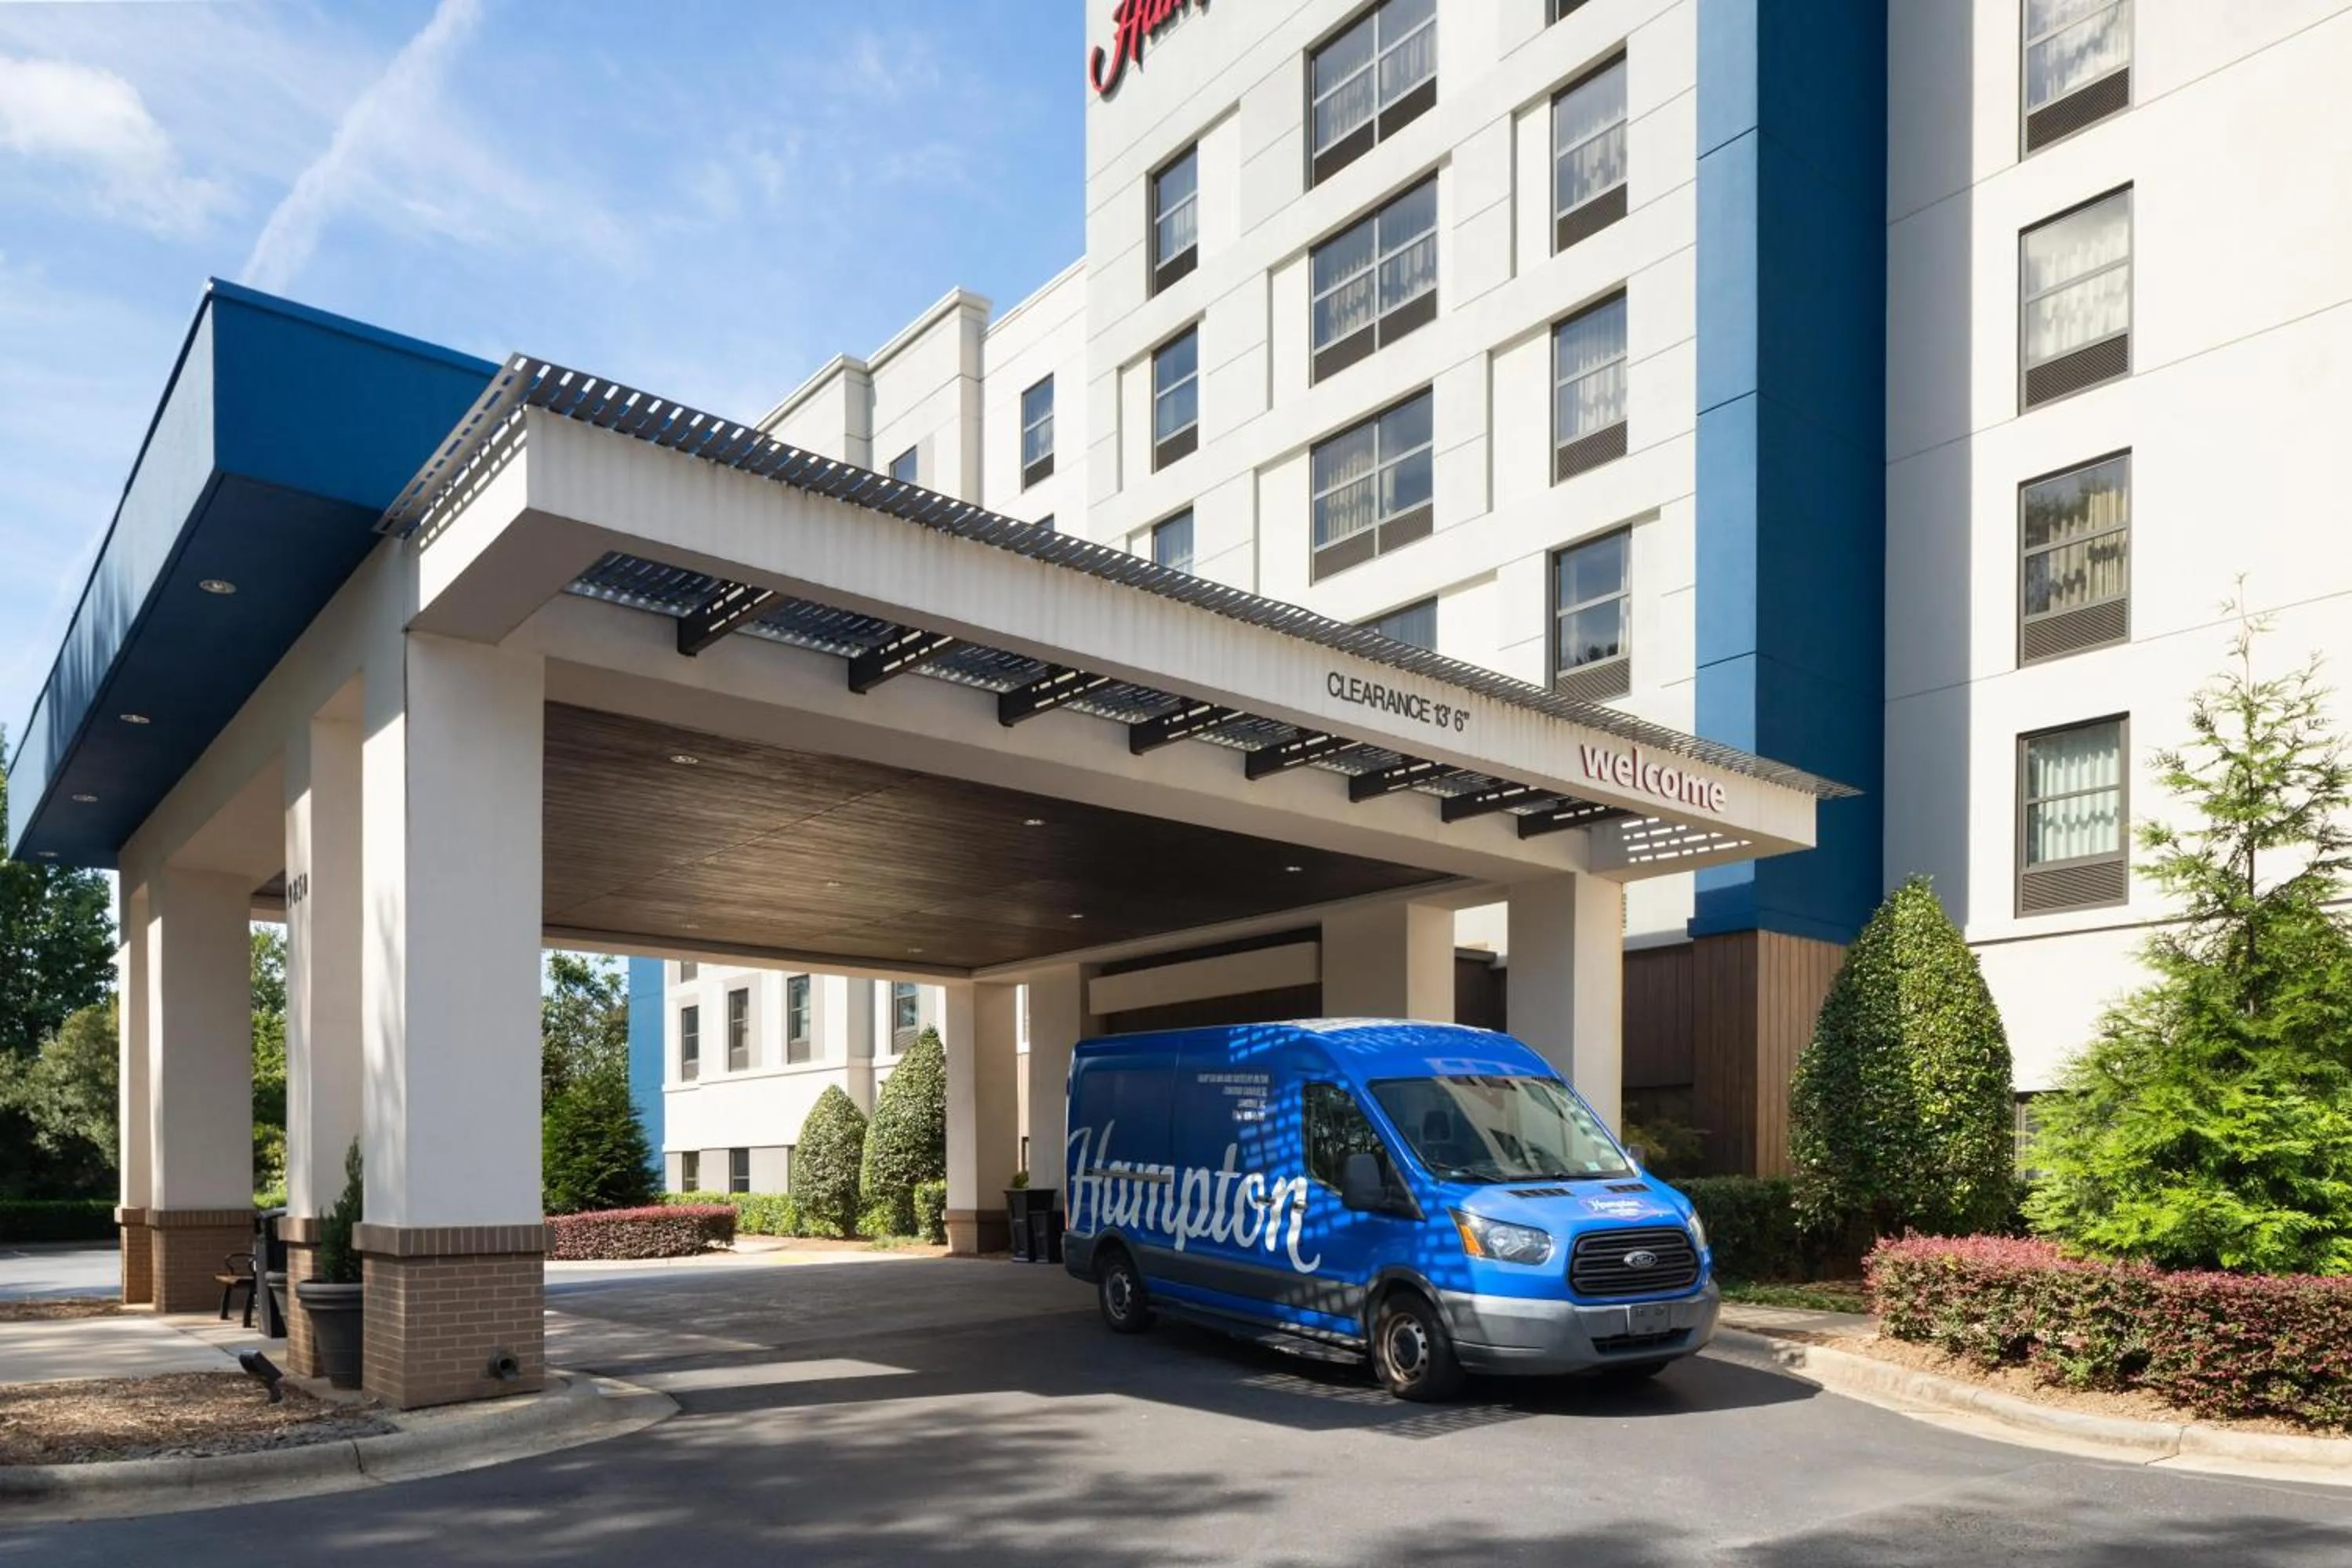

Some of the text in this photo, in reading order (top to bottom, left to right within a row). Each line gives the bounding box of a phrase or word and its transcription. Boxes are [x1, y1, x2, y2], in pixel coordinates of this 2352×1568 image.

[1327, 671, 1431, 723] CLEARANCE
[1581, 740, 1726, 812] welcome
[1068, 1119, 1321, 1274] Hampton
